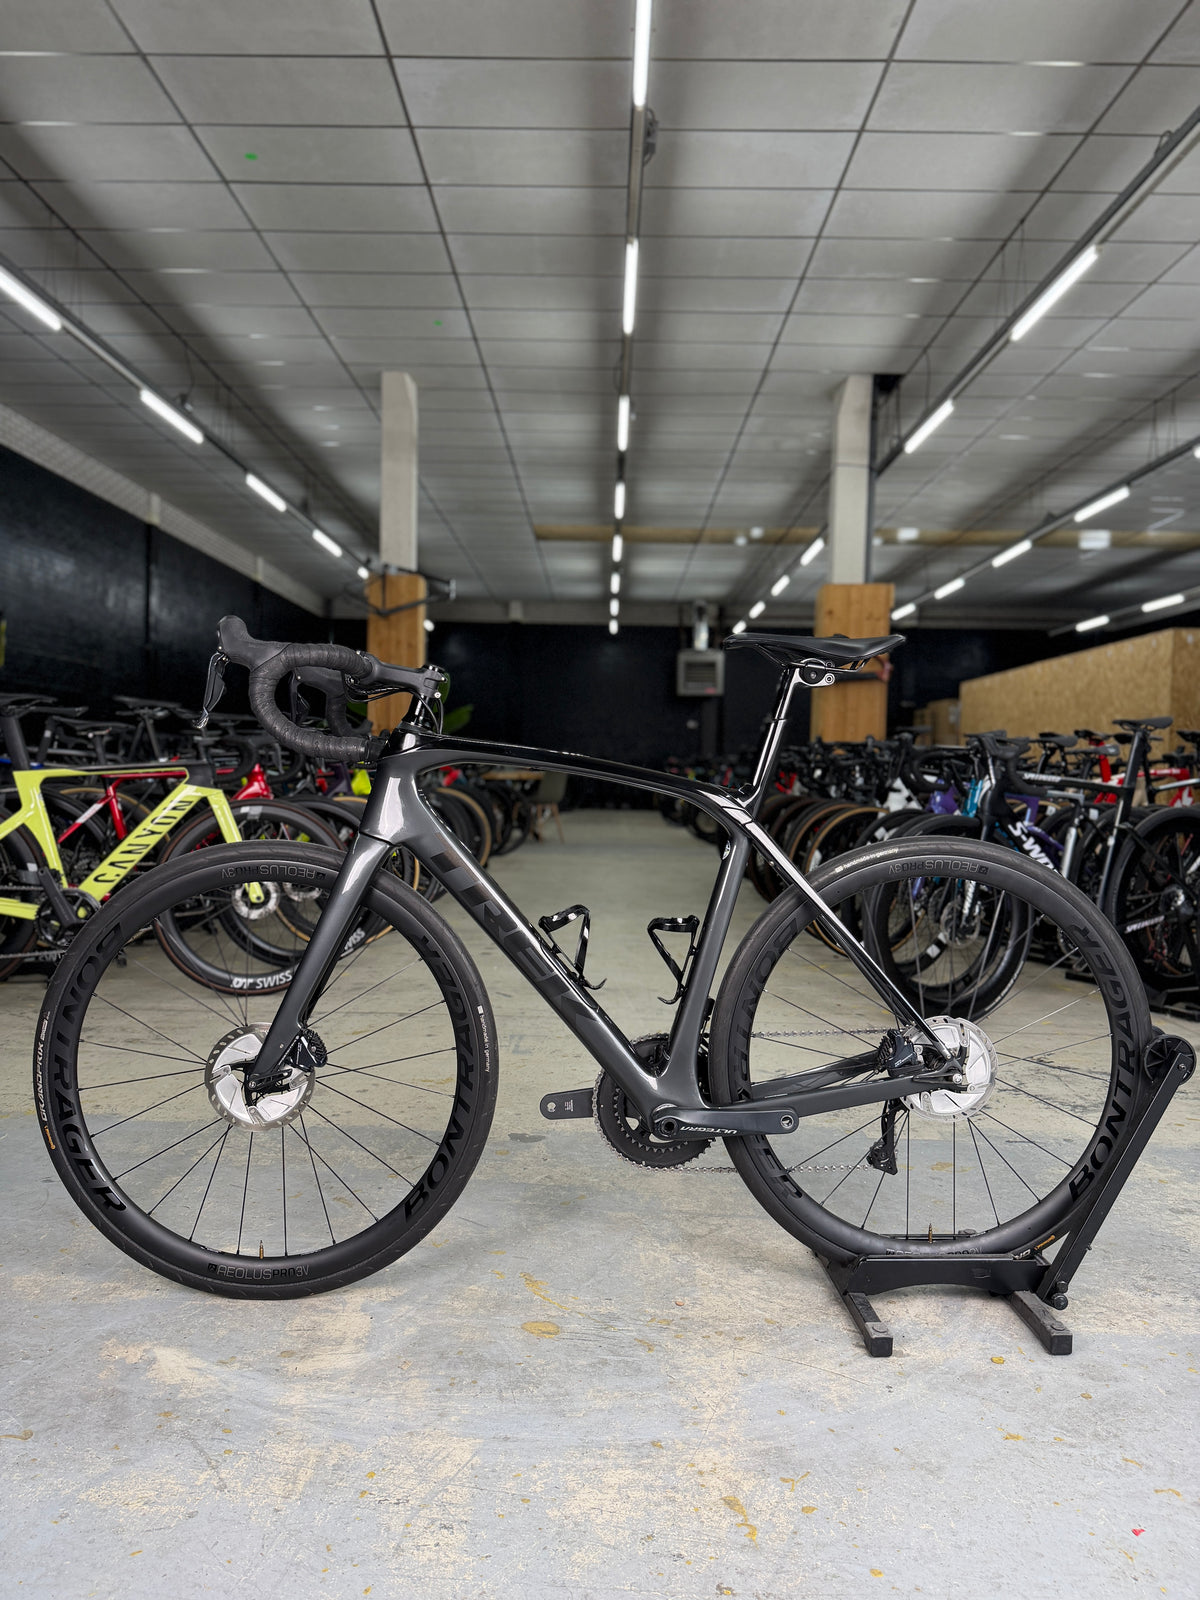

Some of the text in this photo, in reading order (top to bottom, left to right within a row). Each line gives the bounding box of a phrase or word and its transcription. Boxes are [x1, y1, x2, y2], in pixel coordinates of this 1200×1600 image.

[93, 799, 194, 884] CANYON
[256, 970, 293, 989] SWISS
[430, 831, 598, 1026] TREK
[403, 936, 474, 1223] BONTRAGER
[680, 1126, 738, 1135] ULTEGRA
[1069, 924, 1136, 1202] BONTRAGER
